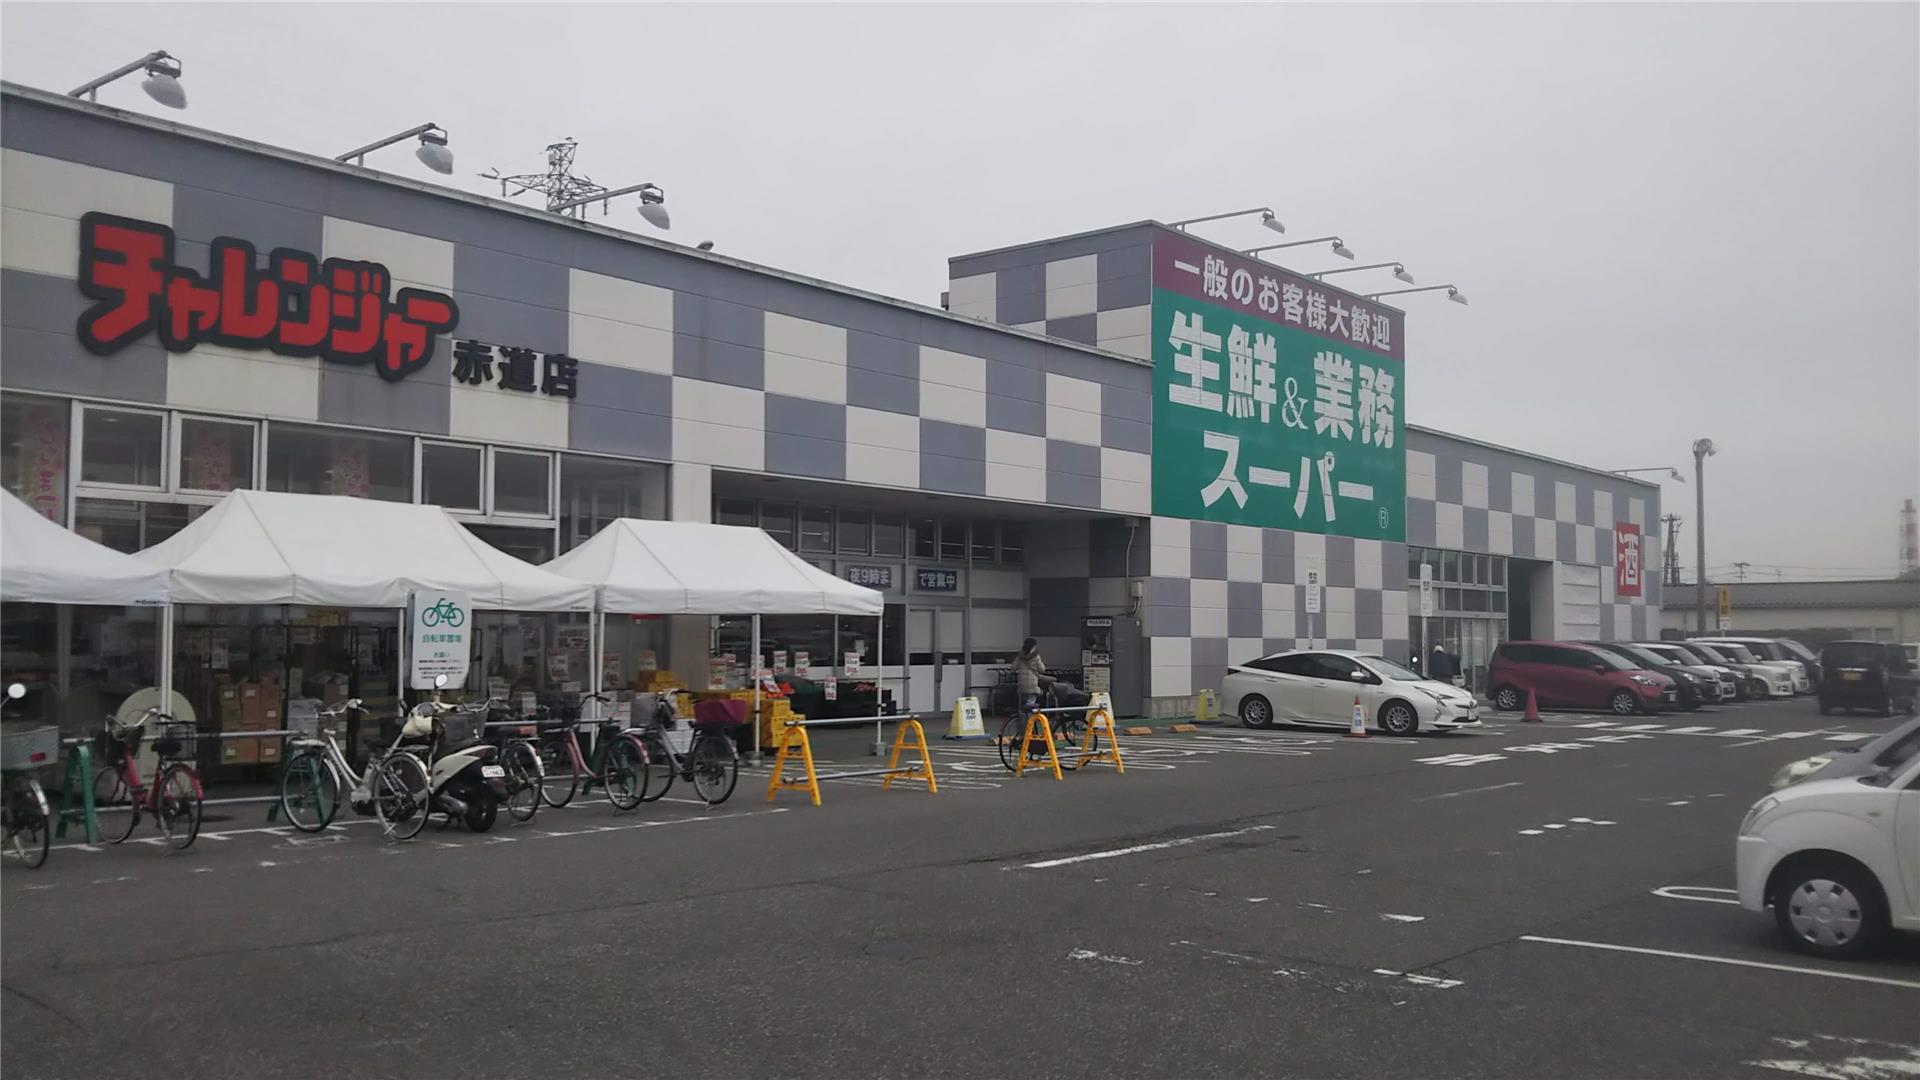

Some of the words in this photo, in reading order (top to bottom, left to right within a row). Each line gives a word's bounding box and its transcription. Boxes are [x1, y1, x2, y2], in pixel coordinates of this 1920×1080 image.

[77, 211, 459, 382] チャレンジャー
[1174, 254, 1391, 351] 一般のお客様大歓迎
[452, 339, 579, 399] 赤道店
[1168, 310, 1395, 449] 生鮮&業務
[1200, 430, 1374, 522] スーパー
[850, 568, 889, 584] 夜9時ま
[920, 572, 955, 588] で営業中
[1618, 530, 1640, 587] 酒
